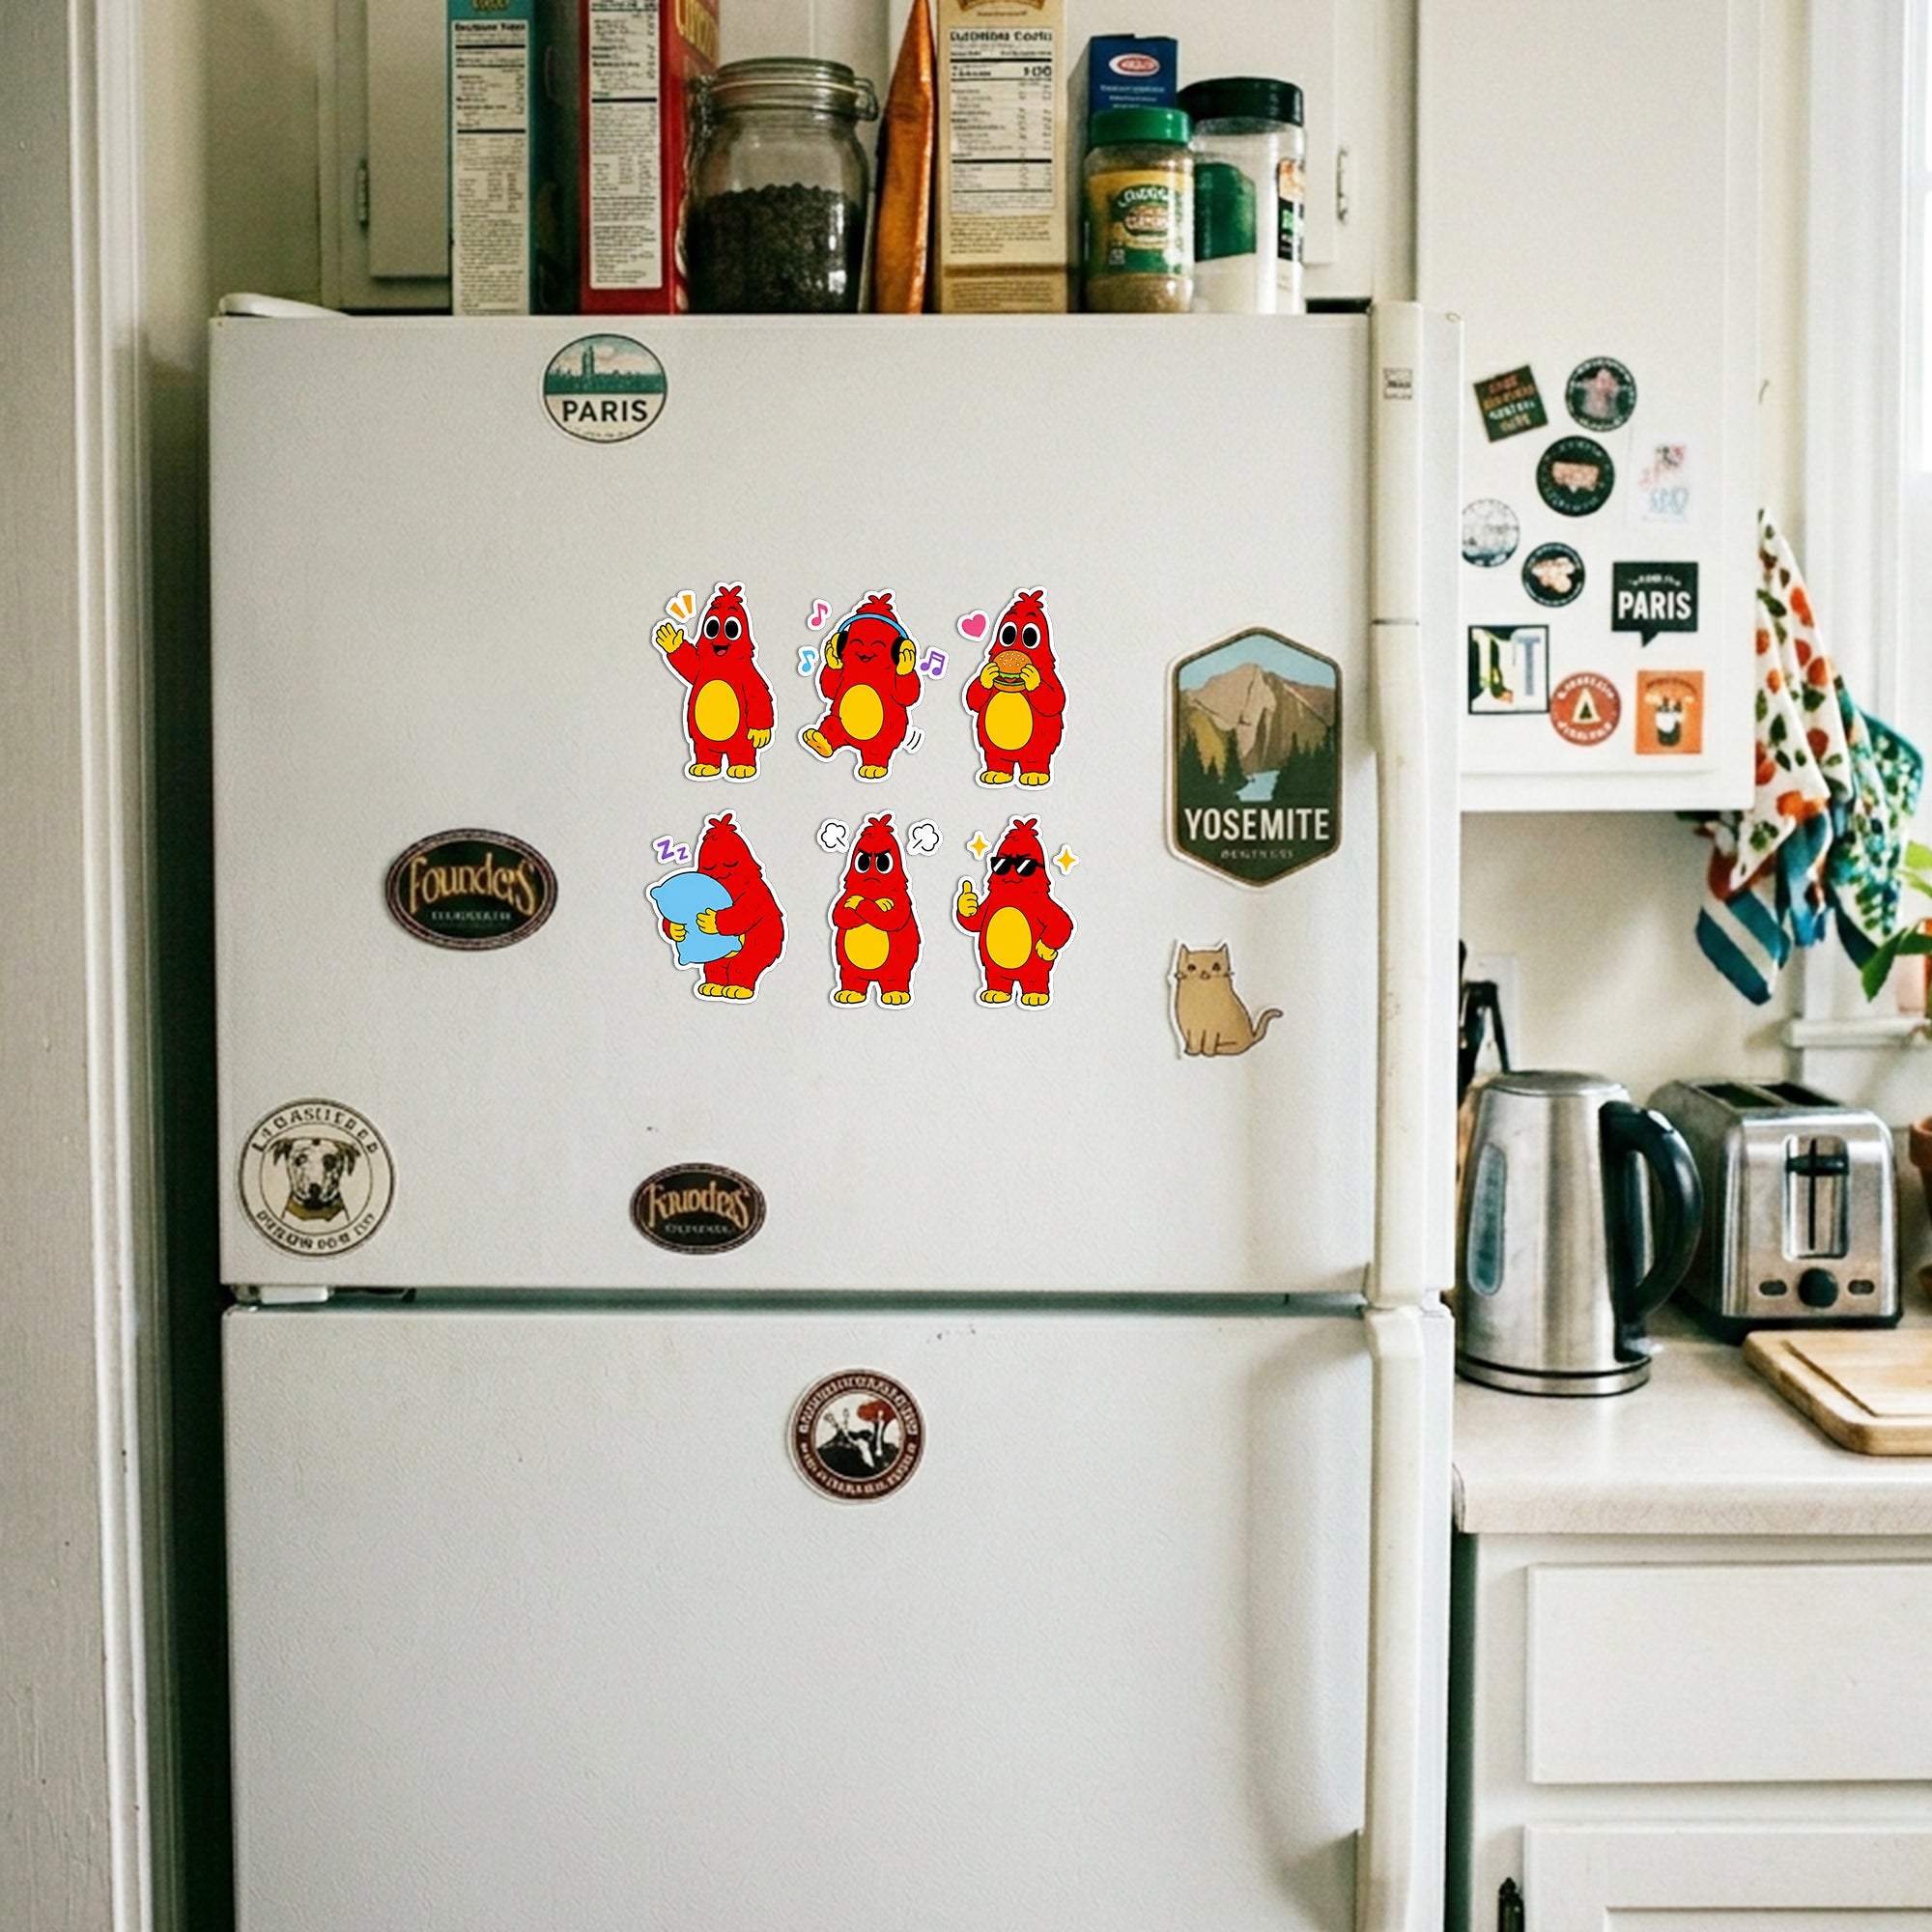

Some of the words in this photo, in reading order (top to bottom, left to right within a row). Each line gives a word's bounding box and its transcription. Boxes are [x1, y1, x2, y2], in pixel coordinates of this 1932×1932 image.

[562, 399, 648, 422] PARIS
[1618, 590, 1692, 620] PARIS
[1184, 808, 1330, 841] YOSEMITE
